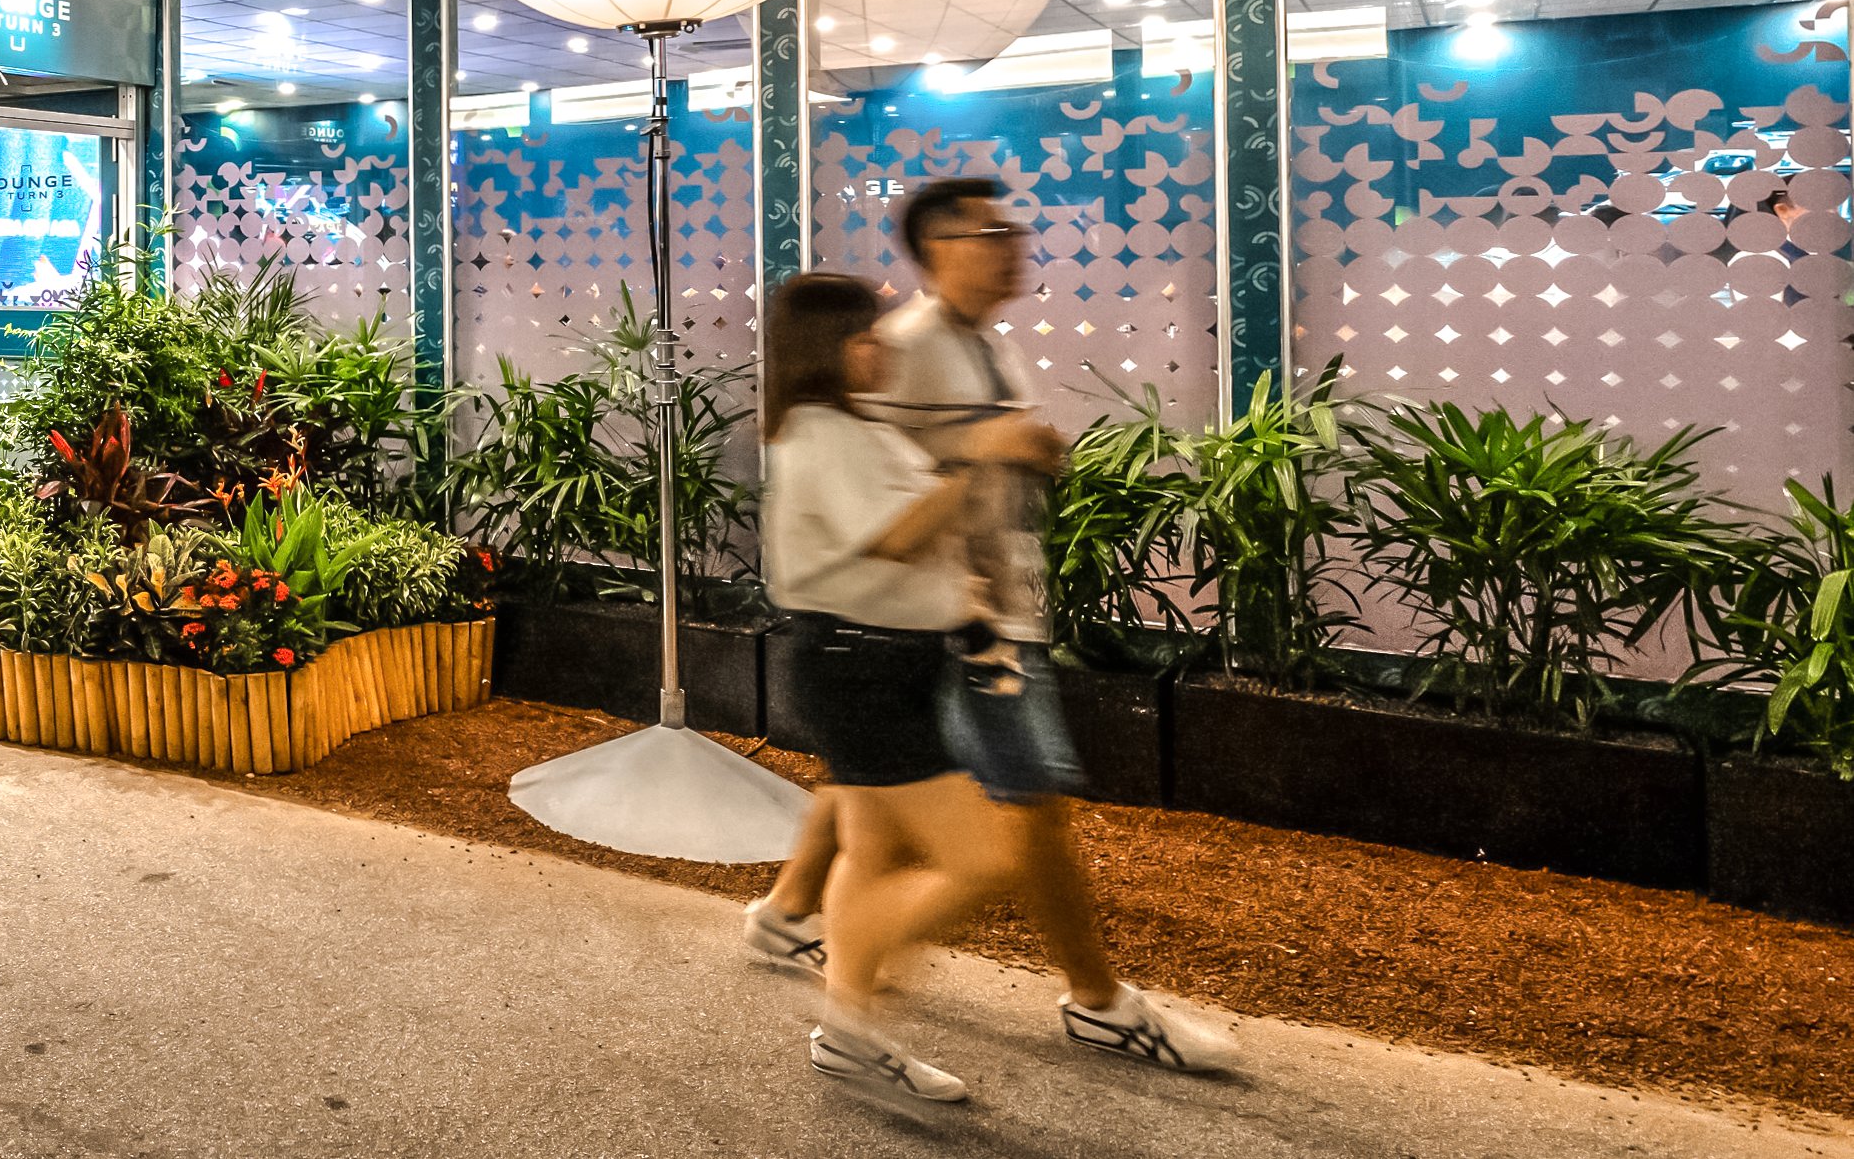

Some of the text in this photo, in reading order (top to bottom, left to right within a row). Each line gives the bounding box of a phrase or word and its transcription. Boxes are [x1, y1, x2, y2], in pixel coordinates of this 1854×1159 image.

[51, 22, 61, 37] 3
[9, 191, 47, 200] TURN
[57, 190, 64, 199] 3
